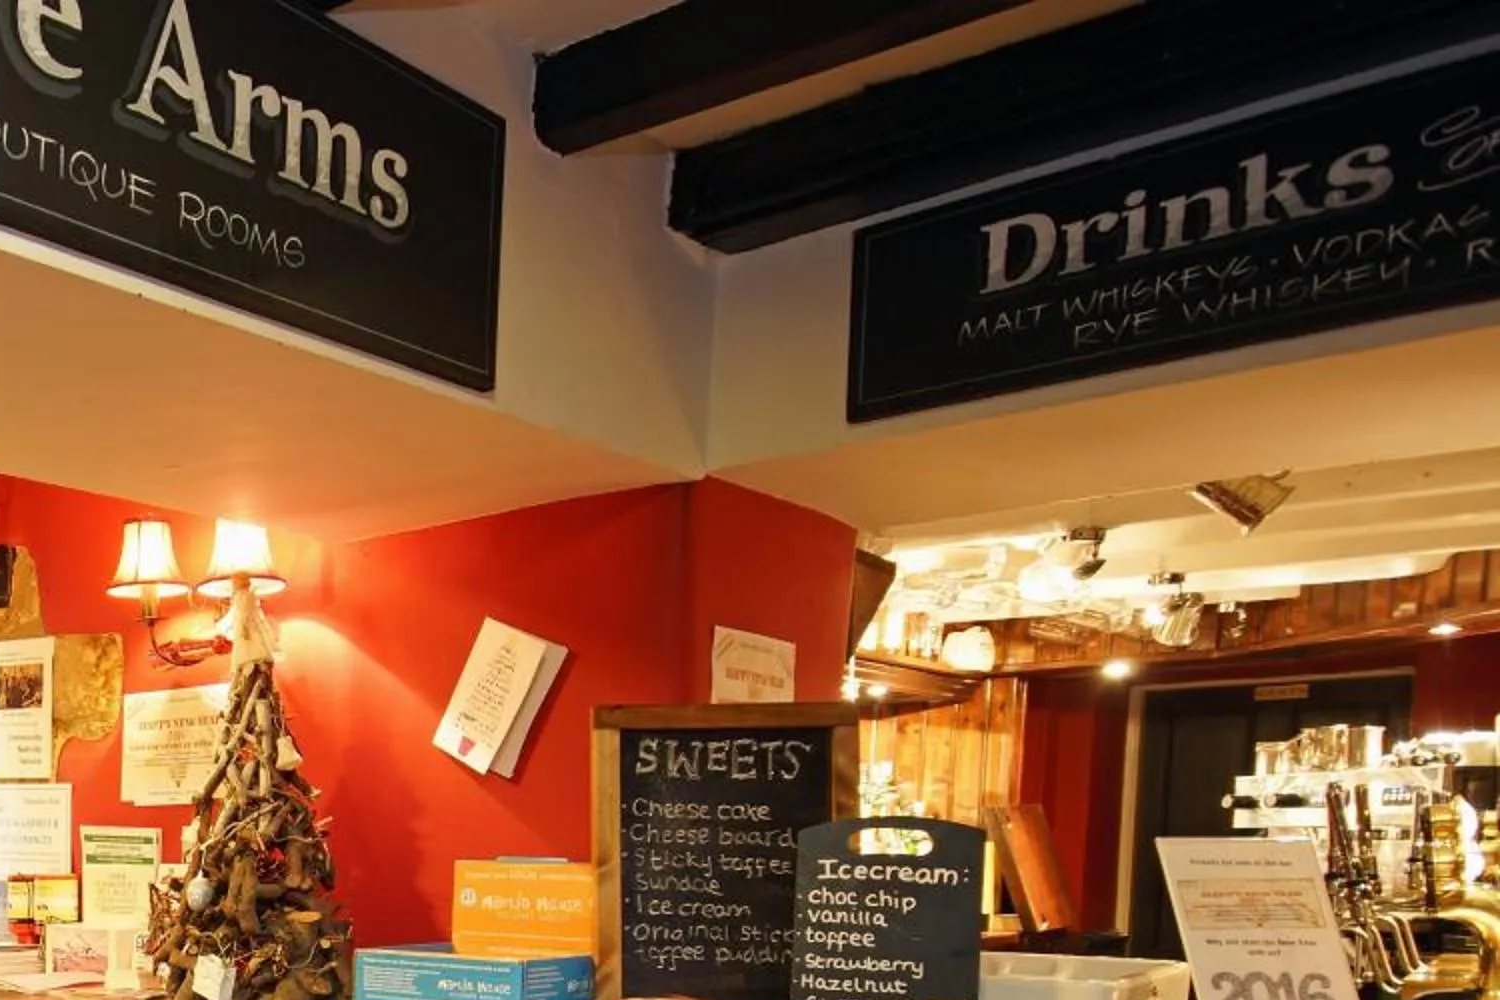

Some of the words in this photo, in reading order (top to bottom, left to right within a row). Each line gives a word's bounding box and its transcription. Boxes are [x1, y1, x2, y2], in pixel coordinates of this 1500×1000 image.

[127, 0, 409, 229] Arms
[177, 191, 306, 269] ROOMS
[979, 144, 1394, 295] Drinks
[1074, 308, 1157, 349] RYE
[1183, 256, 1412, 323] WHISKEY
[957, 303, 1049, 348] MALT
[635, 736, 813, 781] SWEETS
[631, 797, 712, 820] Cheese
[717, 802, 773, 823] cake
[629, 823, 710, 846] Cheese
[718, 826, 799, 849] board
[634, 848, 713, 878] Sticky
[718, 853, 794, 879] toffee
[633, 872, 724, 897] Sundae
[636, 894, 673, 916] Ice
[679, 901, 751, 919] cream
[807, 886, 859, 906] choc
[865, 889, 917, 915] chip
[807, 907, 888, 928] vanilla
[805, 925, 876, 951] toffee
[804, 953, 924, 980] Strawberry
[800, 973, 909, 995] Hazelnut
